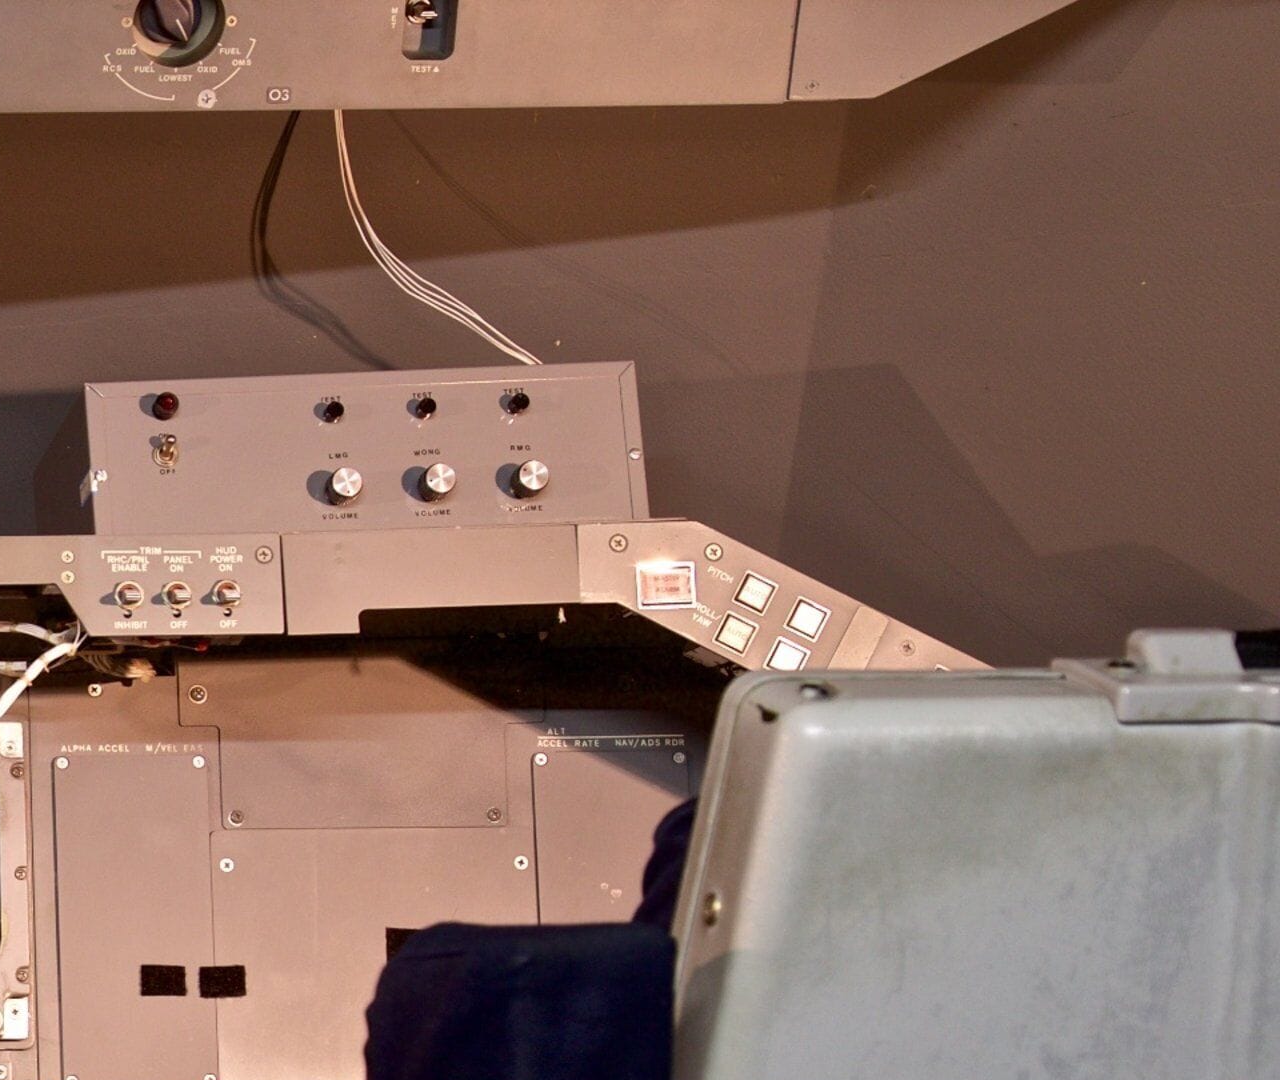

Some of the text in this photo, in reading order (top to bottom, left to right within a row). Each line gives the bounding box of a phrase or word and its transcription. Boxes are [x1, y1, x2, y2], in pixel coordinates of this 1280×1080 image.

[219, 47, 242, 55] FUEL
[197, 65, 218, 73] OXID
[158, 74, 192, 82] LOWEST
[413, 391, 432, 399] TEST
[503, 387, 524, 395] TEST
[510, 444, 532, 452] RMG
[329, 452, 349, 460] LMG
[322, 512, 359, 520] VOLUME
[415, 509, 451, 517] VOLUME
[140, 546, 162, 555] TRIM
[215, 546, 237, 554] HUD
[107, 555, 150, 564] RHC/PNL
[163, 555, 193, 563] PANEL
[210, 555, 243, 563] POWER
[111, 564, 147, 572] ENABLE
[170, 564, 184, 572] ON
[218, 563, 232, 572] ON
[707, 565, 734, 584] PITCH
[219, 620, 238, 628] OFF
[692, 613, 713, 628] YAW
[114, 621, 147, 629] INHIBIT
[170, 621, 188, 629] OFF
[547, 728, 566, 736] ALT
[537, 738, 685, 748] ACCEL RATE NAV/ADS RDR
[60, 744, 130, 753] ALPHA ACCEL
